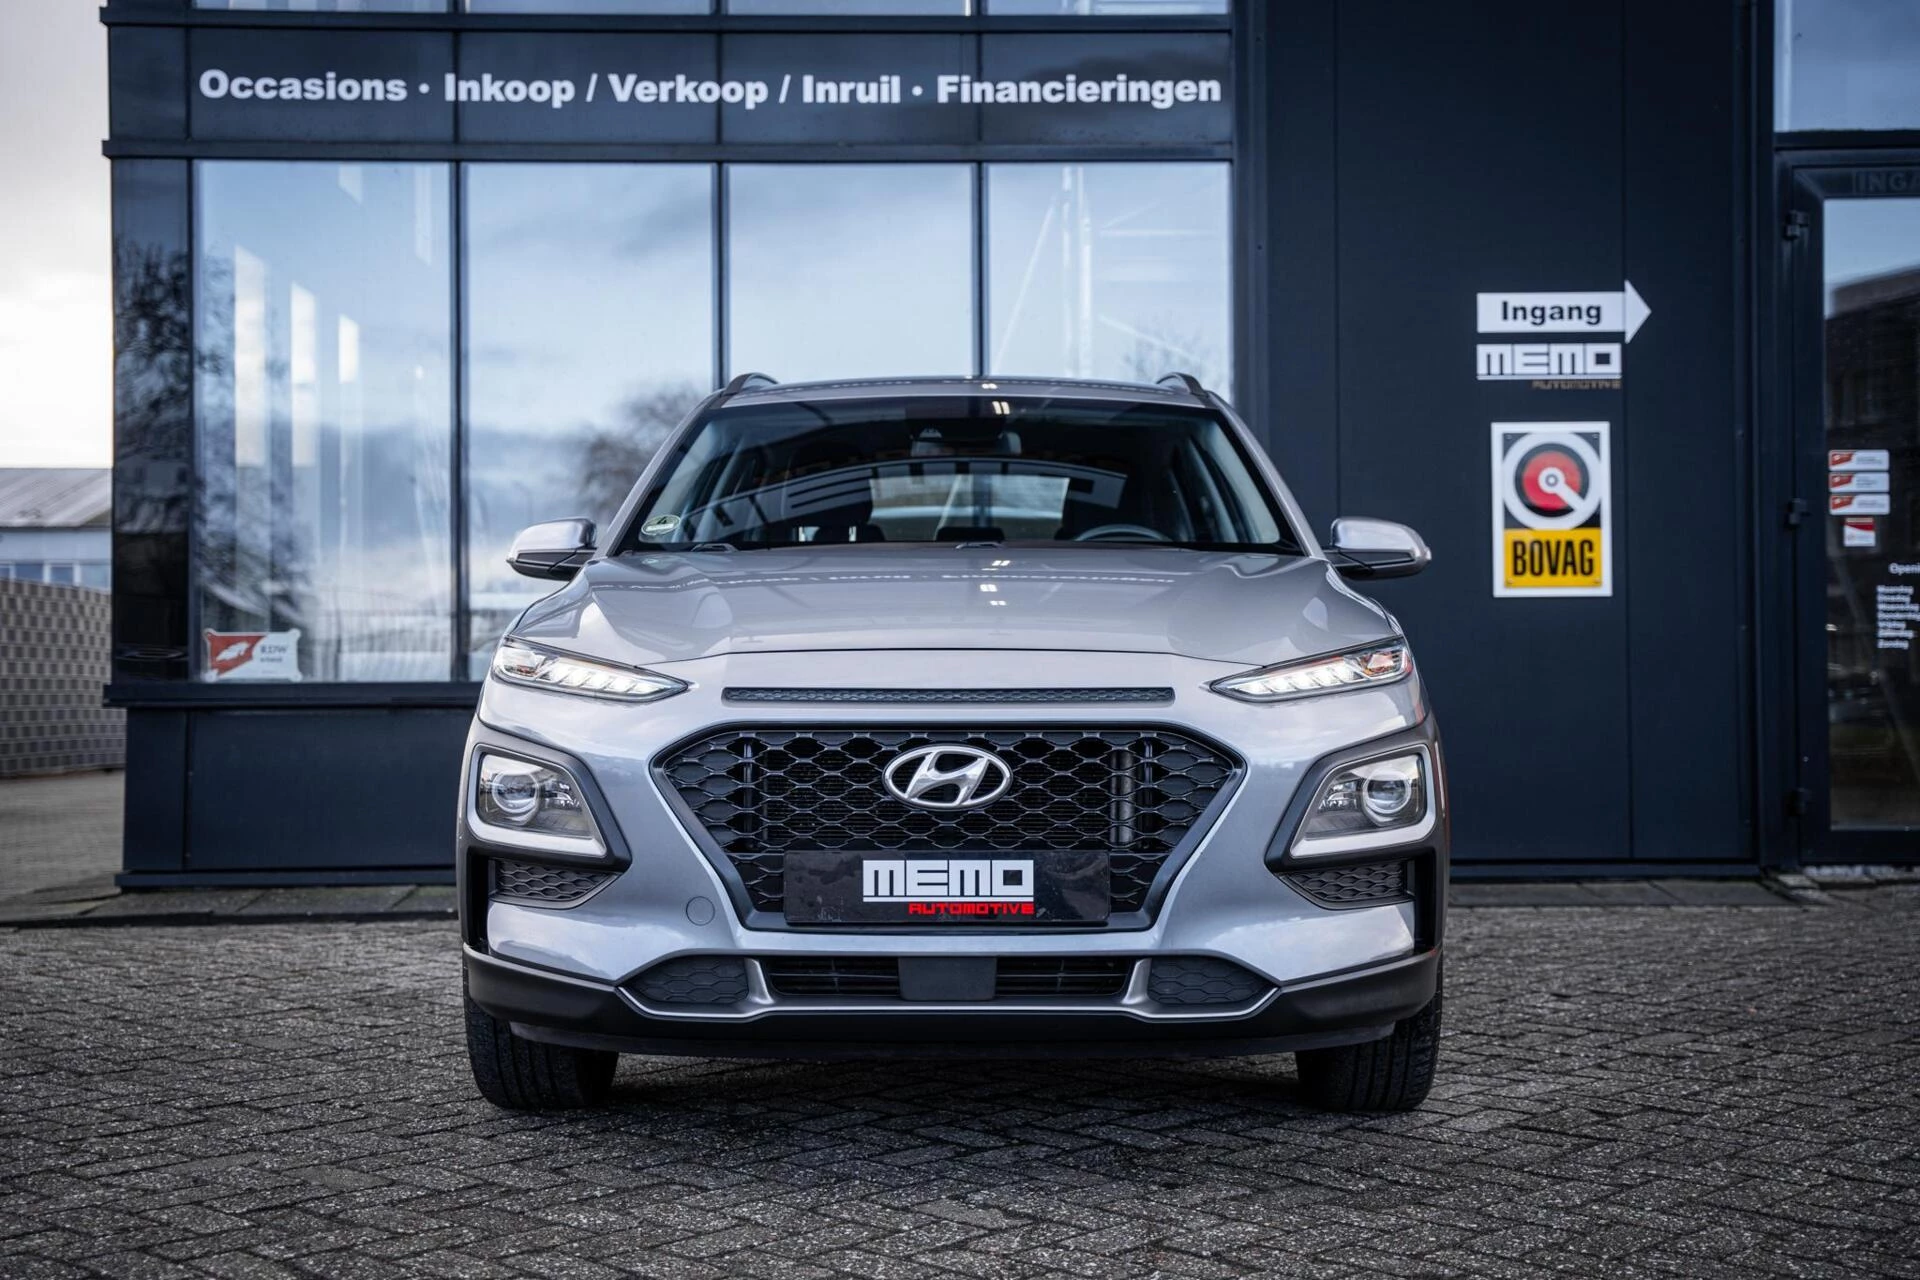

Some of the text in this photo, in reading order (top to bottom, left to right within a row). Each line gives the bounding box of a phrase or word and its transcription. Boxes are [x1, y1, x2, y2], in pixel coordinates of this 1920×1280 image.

[200, 69, 407, 100] Occasions
[446, 74, 575, 108] Inkoop
[608, 74, 768, 109] Verkoop
[803, 75, 900, 103] Inruil
[938, 75, 1220, 109] Financieringen
[1502, 301, 1602, 326] Ingang
[1477, 343, 1621, 375] MEMO
[1512, 540, 1594, 577] BOVAG
[863, 860, 1034, 896] MEMO
[909, 902, 1034, 915] AUTOMOTIVE
